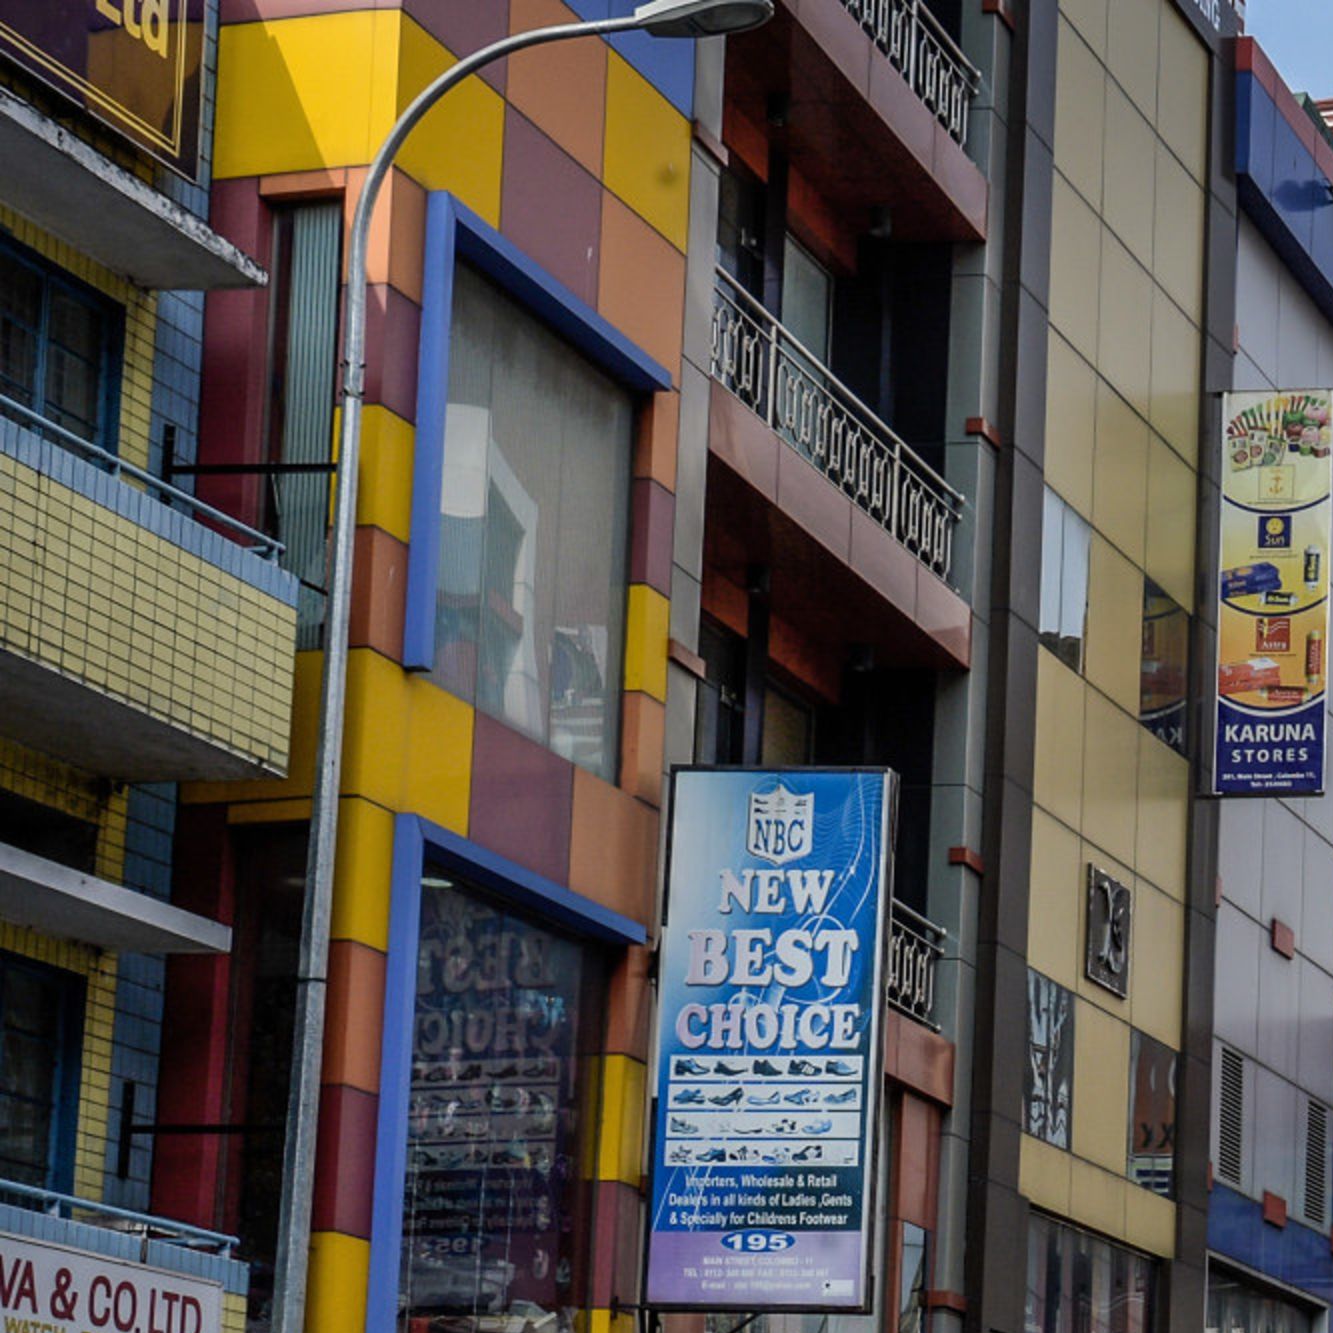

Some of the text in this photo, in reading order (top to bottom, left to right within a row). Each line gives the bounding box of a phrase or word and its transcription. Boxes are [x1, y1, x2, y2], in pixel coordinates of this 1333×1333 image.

[1265, 534, 1285, 546] Sun
[1225, 723, 1316, 743] KARUNA
[1231, 747, 1308, 763] STORES
[754, 817, 807, 858] NBC
[717, 868, 836, 915] NEW
[685, 928, 859, 989] BEST
[674, 1002, 863, 1052] CHOICE
[741, 1174, 794, 1187] Wholesale
[796, 1174, 805, 1187] &
[807, 1174, 838, 1187] Retail
[668, 1194, 708, 1208] Dealers
[710, 1194, 720, 1207] in
[722, 1193, 735, 1207] all
[737, 1193, 767, 1207] kinds
[769, 1193, 781, 1207] of
[782, 1194, 817, 1207] Ladies
[669, 1211, 849, 1227] & Specially for Childrens Footwear
[727, 1233, 789, 1250] 195
[50, 1267, 79, 1322] &
